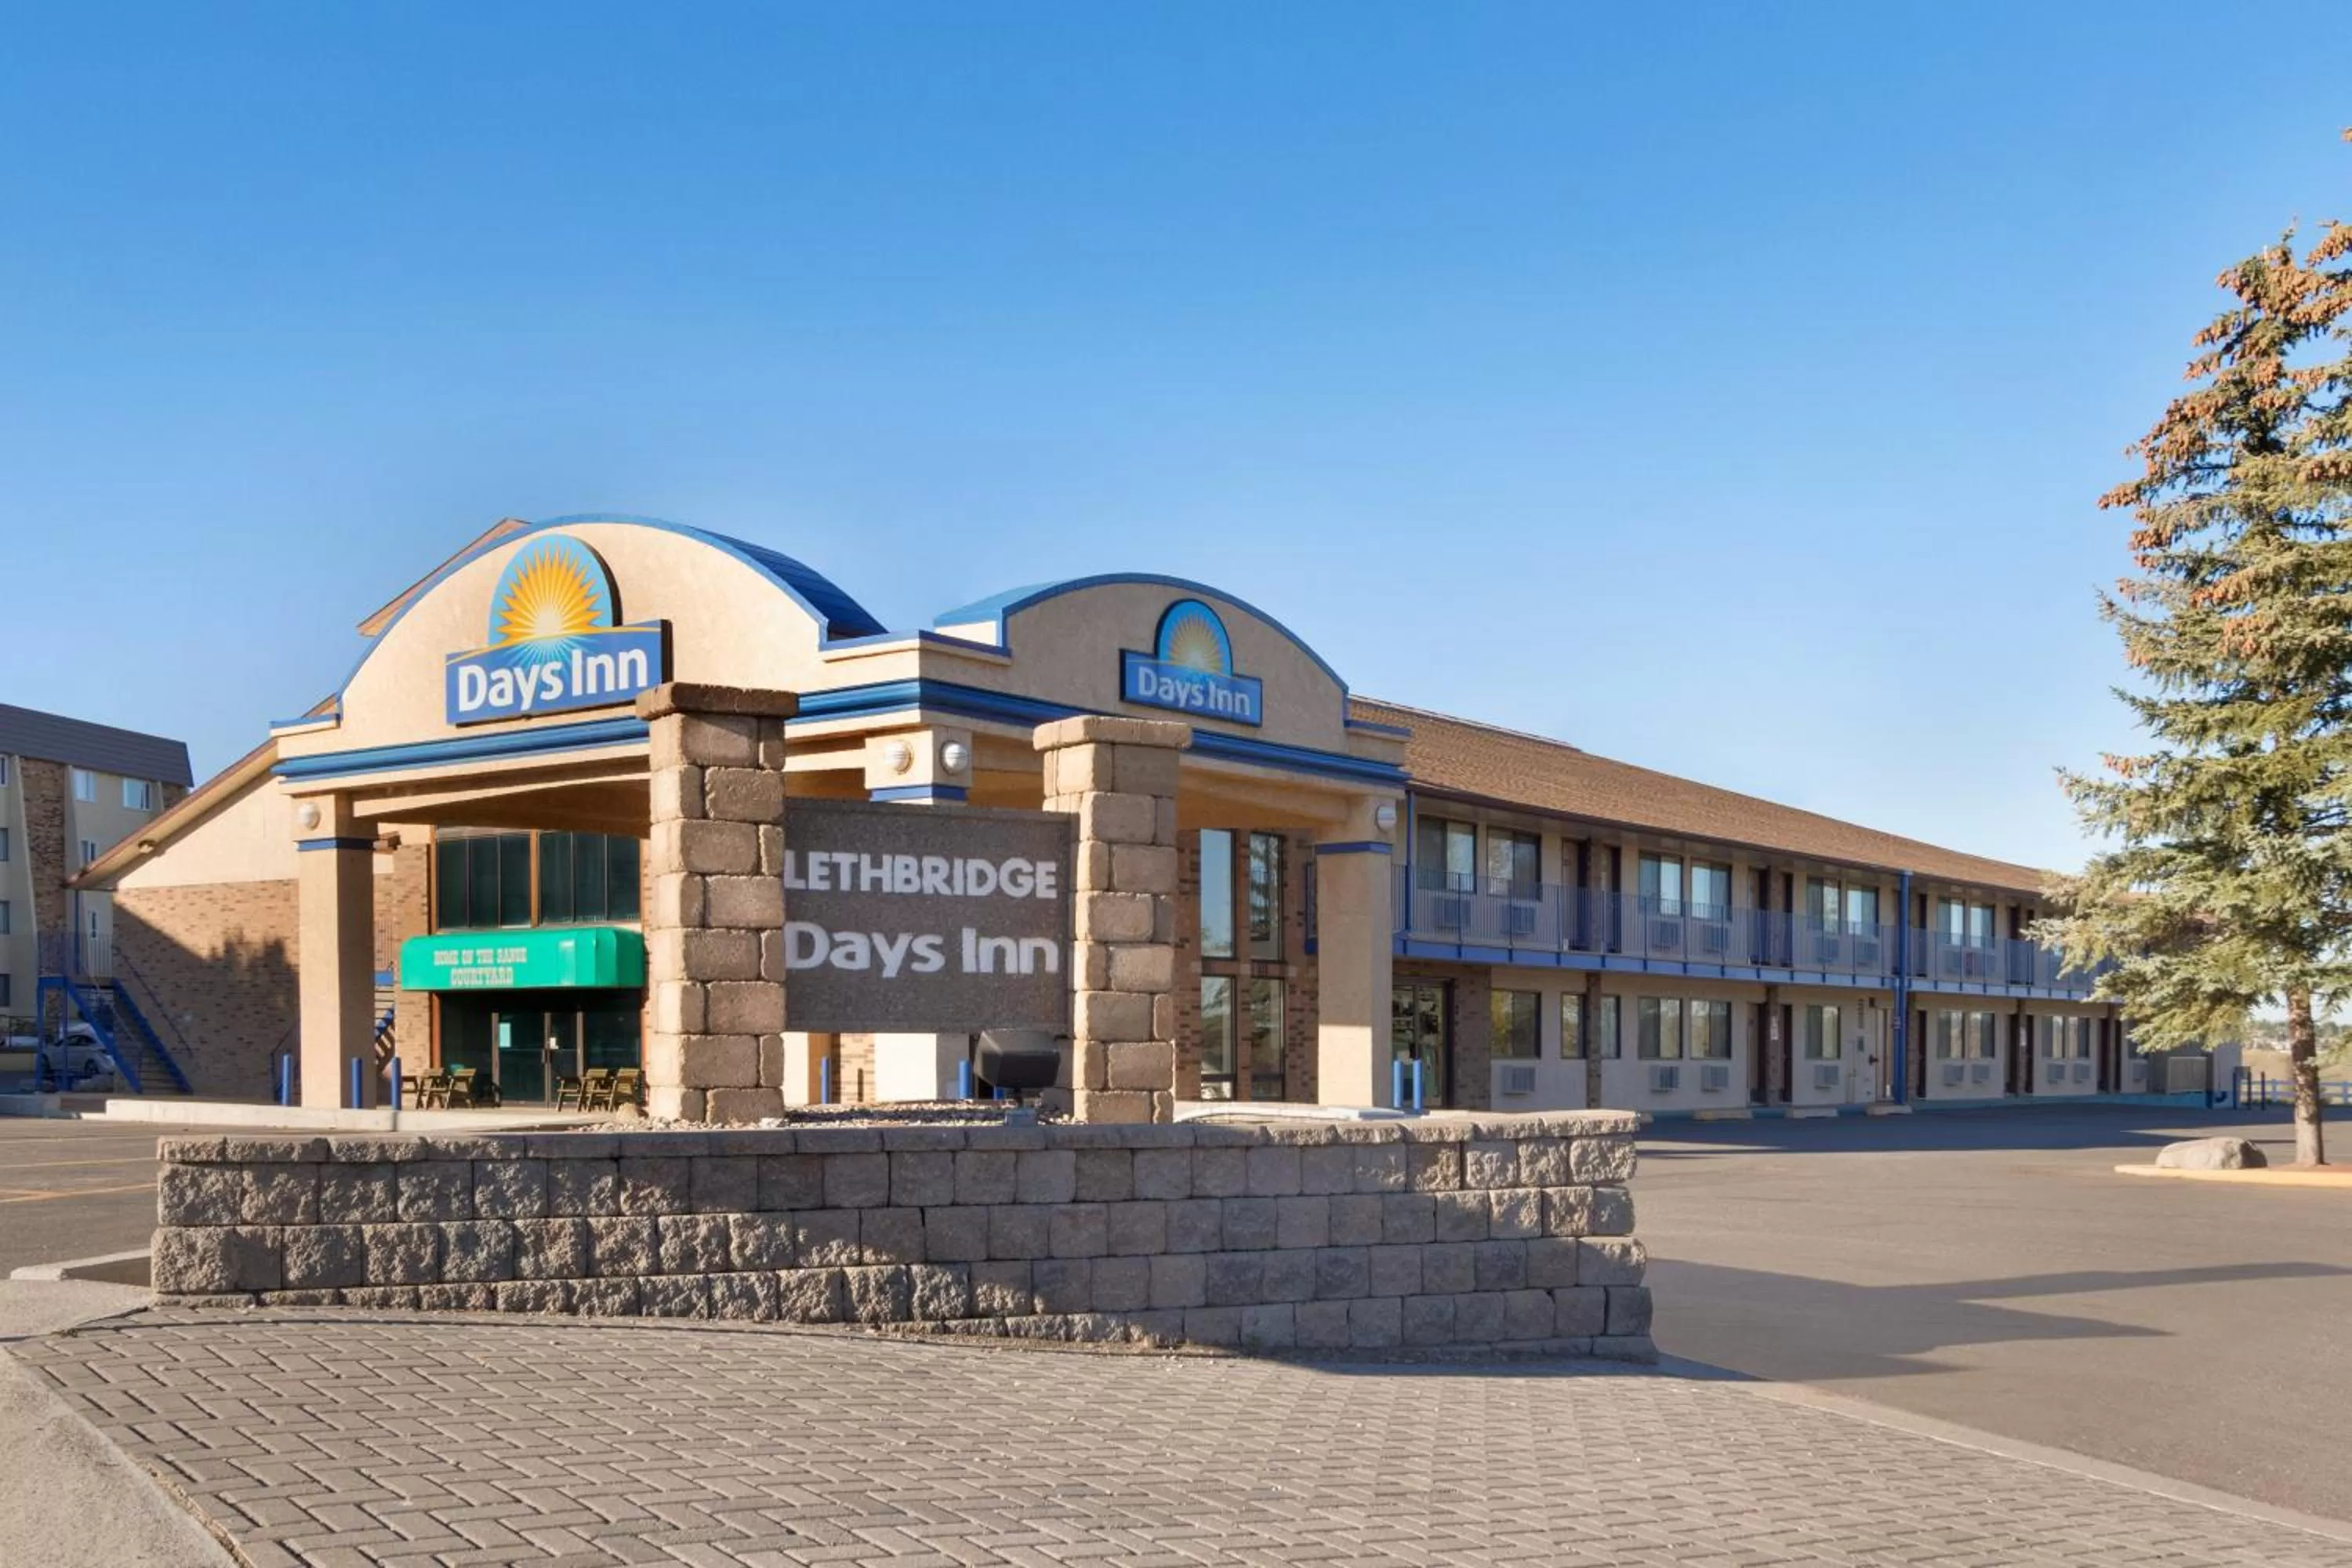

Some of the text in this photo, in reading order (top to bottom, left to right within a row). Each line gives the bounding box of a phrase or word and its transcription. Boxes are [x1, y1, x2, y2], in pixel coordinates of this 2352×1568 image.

[458, 648, 648, 713] Days Inn
[1138, 666, 1251, 716] Days Inn
[783, 850, 1058, 899] LETHBRIDGE
[784, 921, 1059, 978] Days Inn
